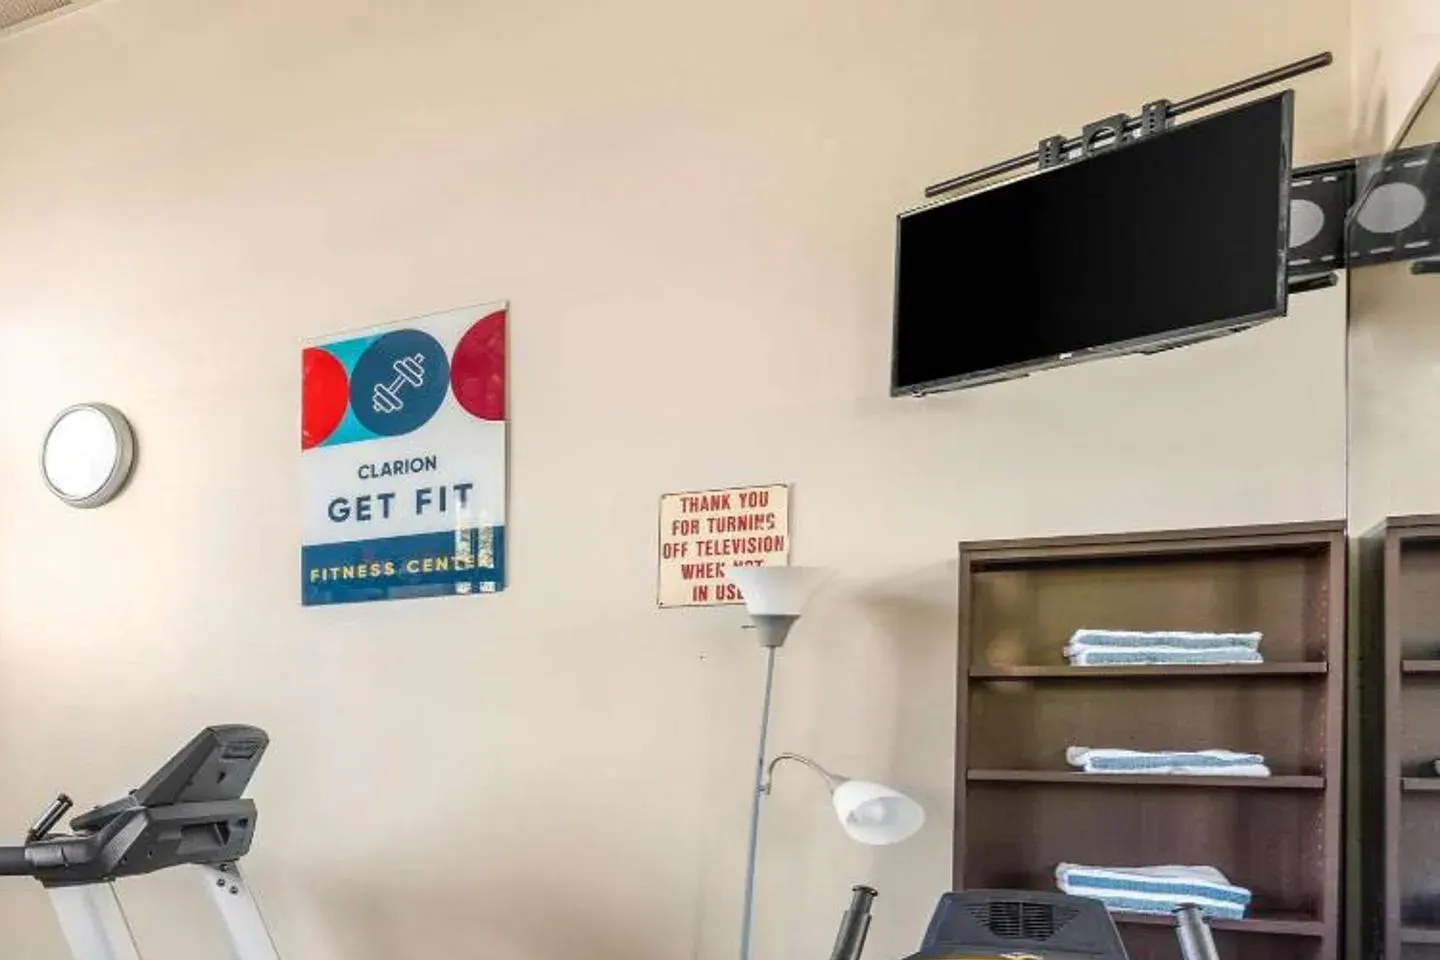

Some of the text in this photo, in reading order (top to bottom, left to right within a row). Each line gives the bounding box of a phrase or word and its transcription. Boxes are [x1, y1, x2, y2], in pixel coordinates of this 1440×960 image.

[358, 455, 437, 480] CLARION
[327, 482, 474, 523] GET FIT
[680, 491, 769, 513] THANK YOU
[672, 519, 700, 536] FOR
[663, 535, 785, 559] OFF TELEVISION
[310, 562, 395, 583] FITNESS
[681, 562, 726, 580] WHEN
[692, 585, 708, 602] IN
